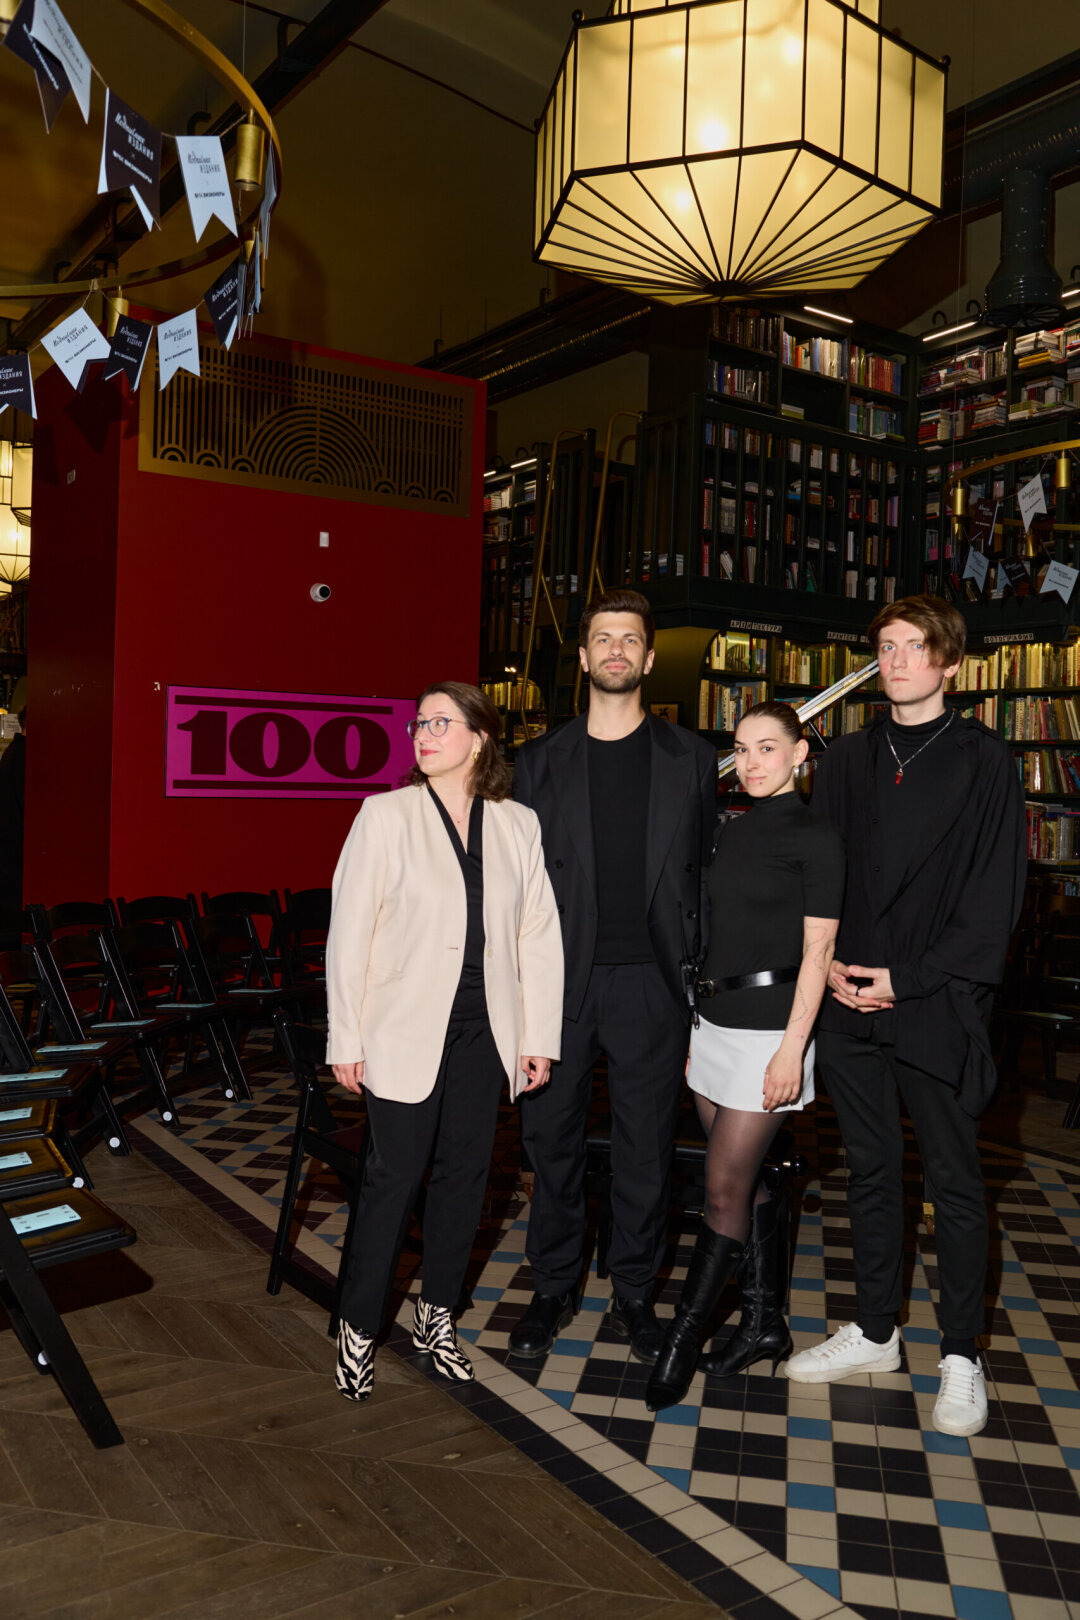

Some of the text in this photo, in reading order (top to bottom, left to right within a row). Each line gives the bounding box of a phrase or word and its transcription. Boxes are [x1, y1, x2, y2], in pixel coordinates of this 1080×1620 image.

[128, 134, 154, 161] ИЗДАНИЯ
[984, 633, 1034, 643] ФОТОГРАФИЯ
[177, 710, 391, 779] 100
